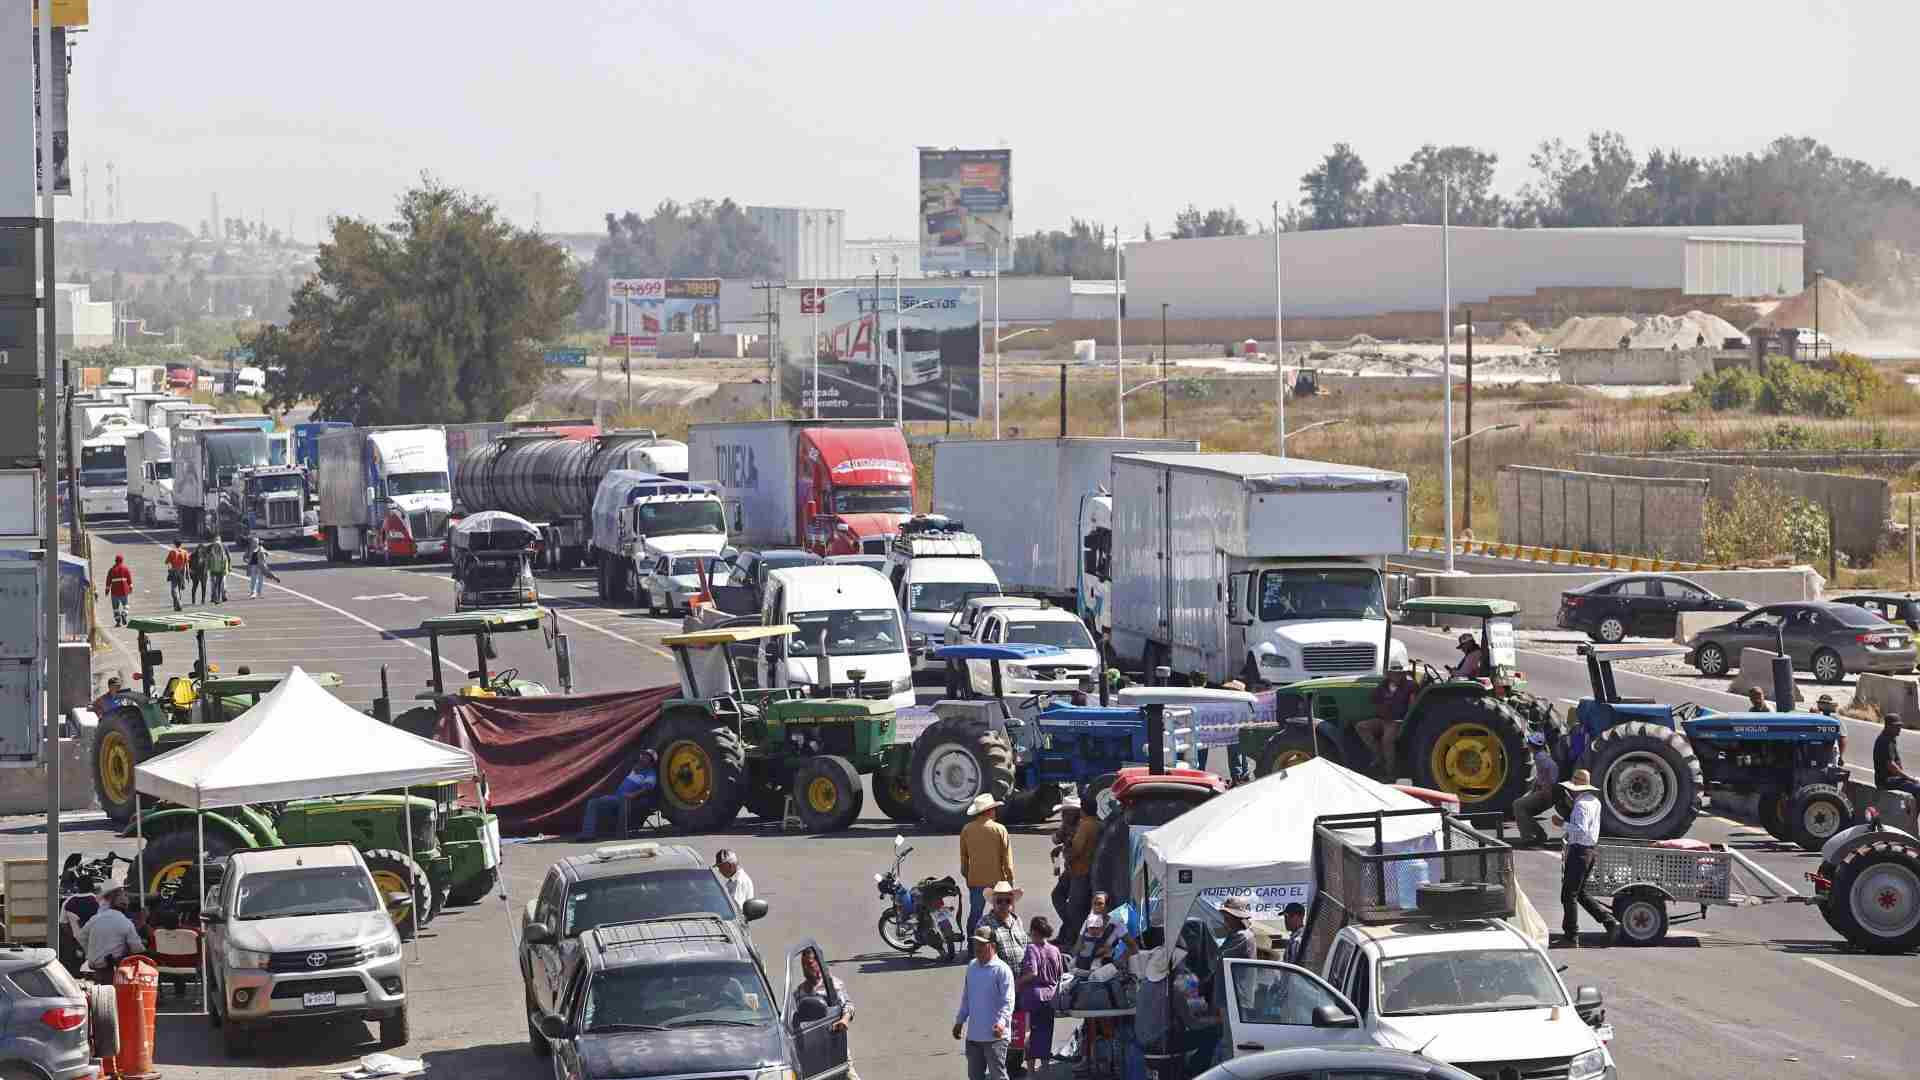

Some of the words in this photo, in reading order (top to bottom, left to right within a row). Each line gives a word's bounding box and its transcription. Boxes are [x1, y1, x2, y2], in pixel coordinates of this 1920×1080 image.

[801, 398, 849, 409] kilmetro
[1255, 887, 1287, 897] CARO
[1290, 887, 1304, 896] EL
[1256, 903, 1272, 912] DE
